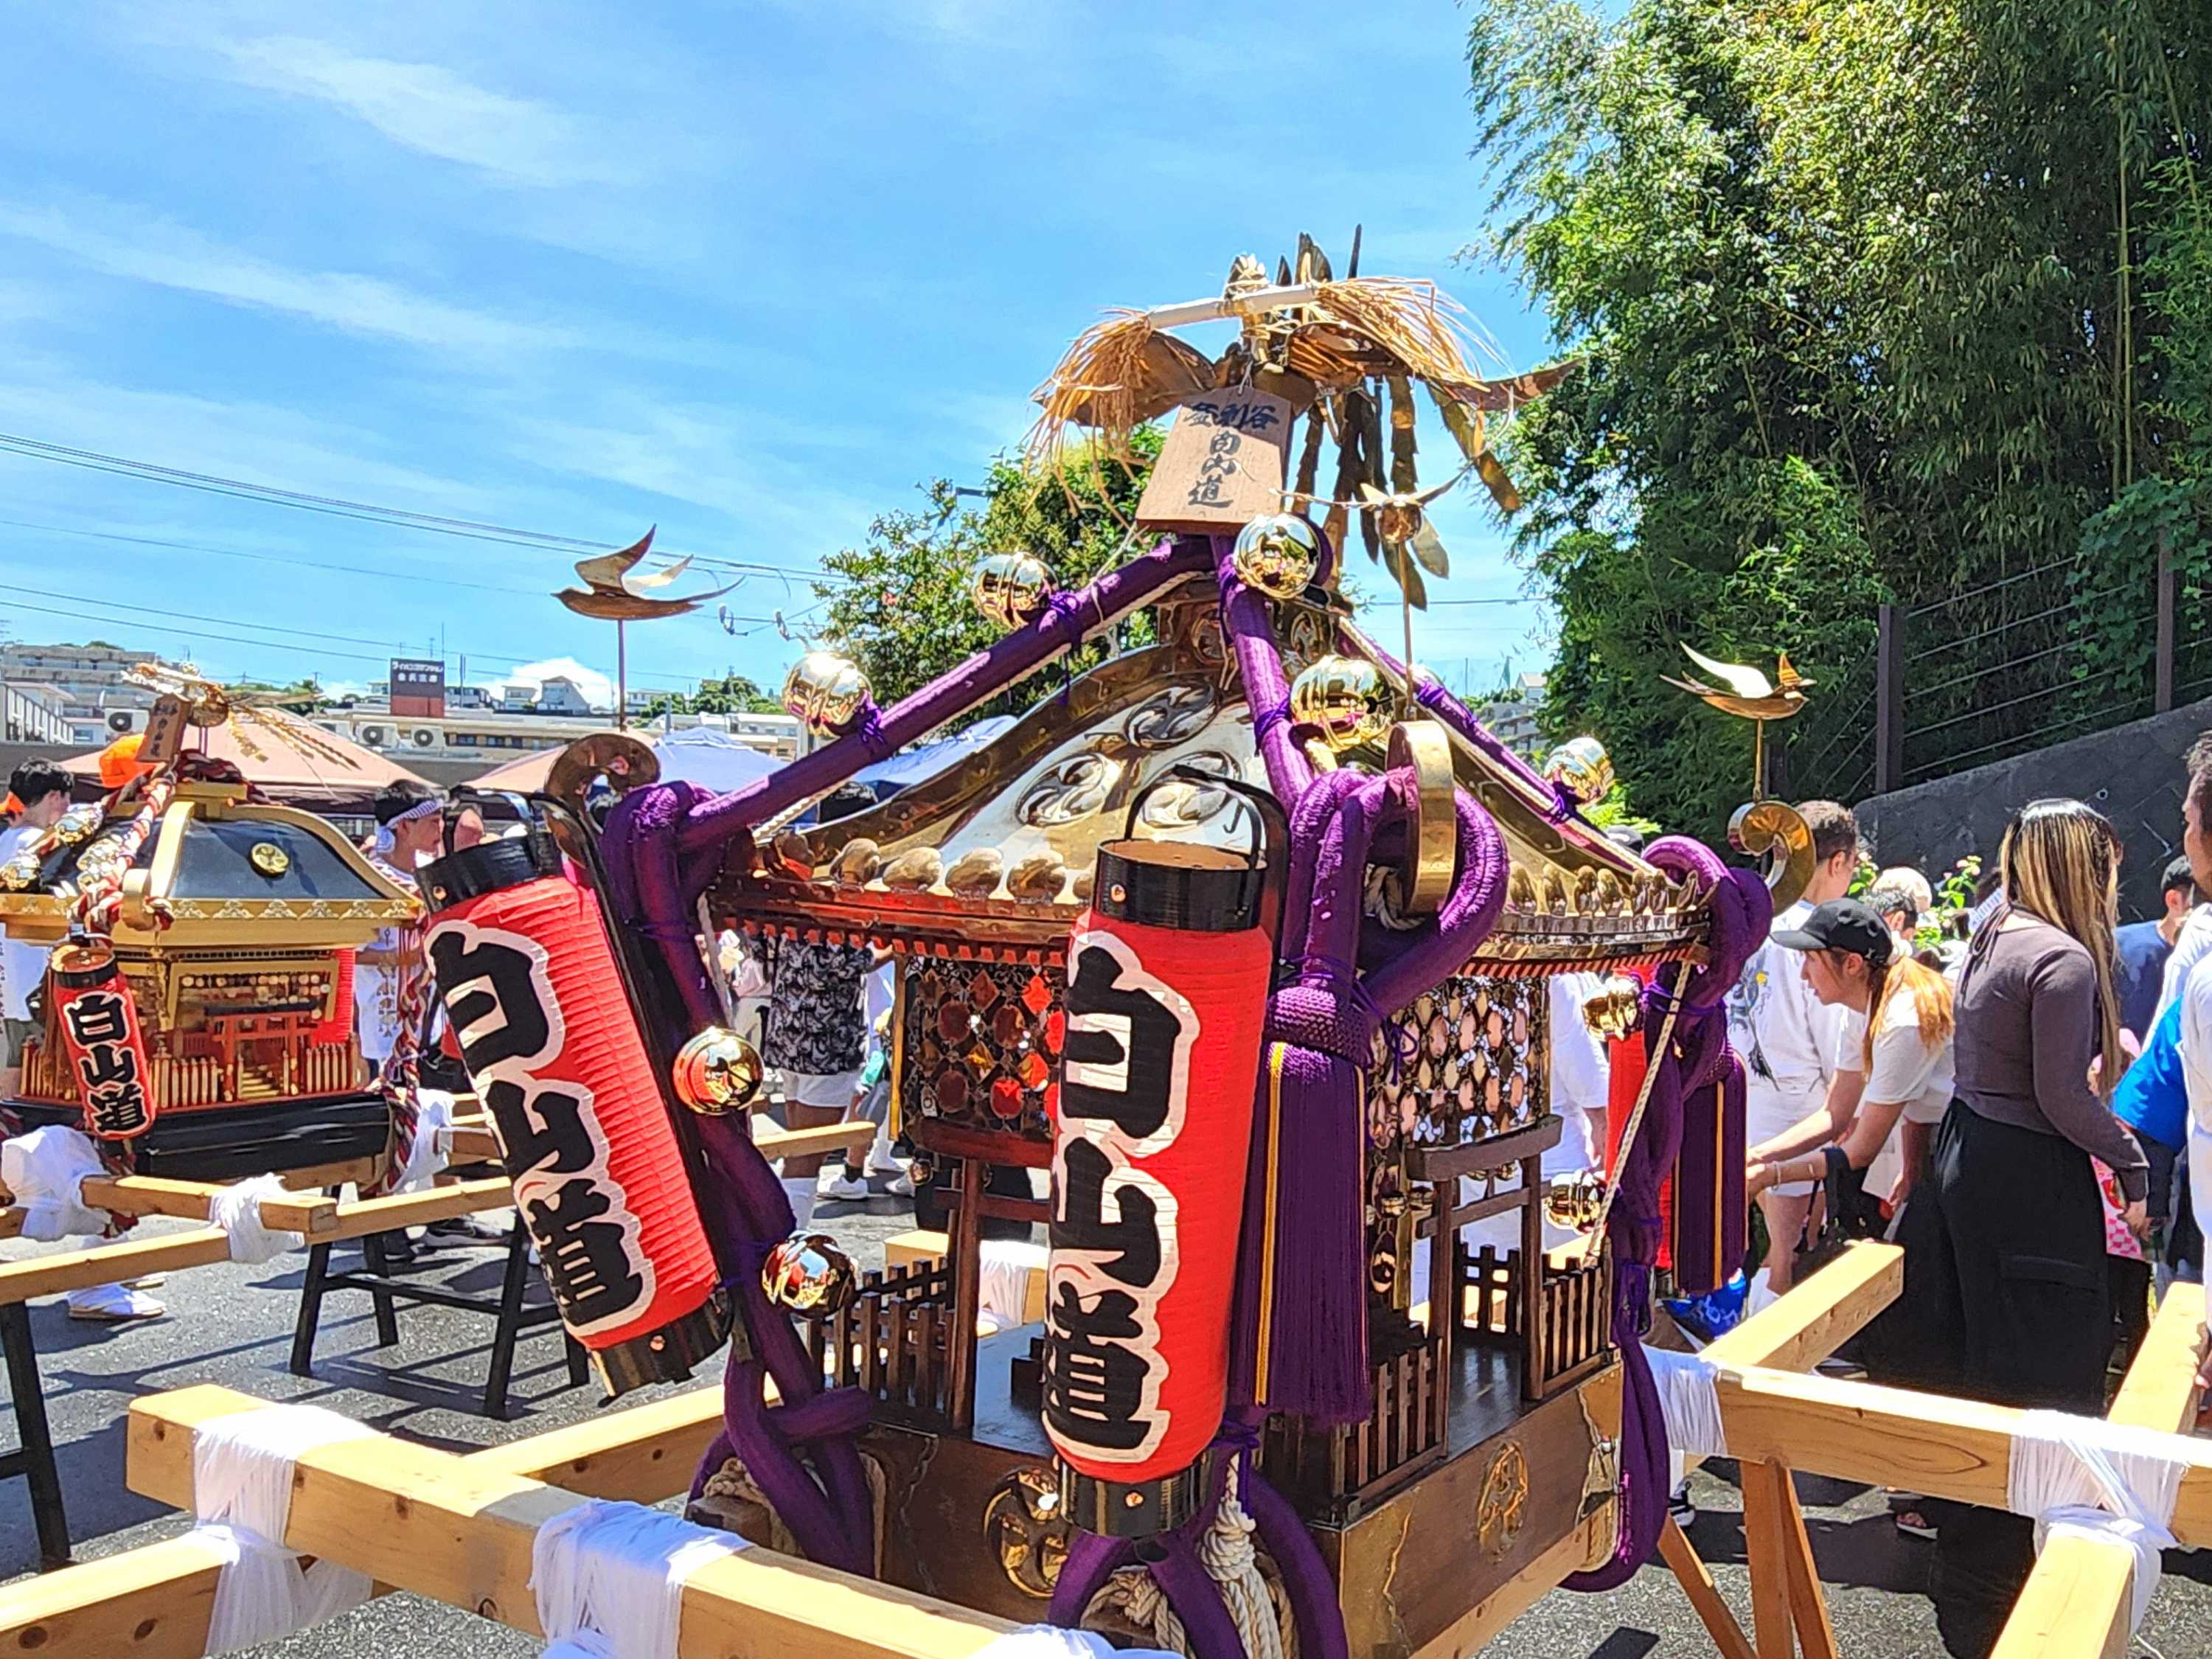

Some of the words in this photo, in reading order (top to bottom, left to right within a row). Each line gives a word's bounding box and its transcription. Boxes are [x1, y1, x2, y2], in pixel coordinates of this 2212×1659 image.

[1187, 431, 1242, 509] 白山道
[66, 993, 147, 1133] 白山道
[430, 930, 644, 1327] 白山道
[1042, 945, 1183, 1450] 白山道
